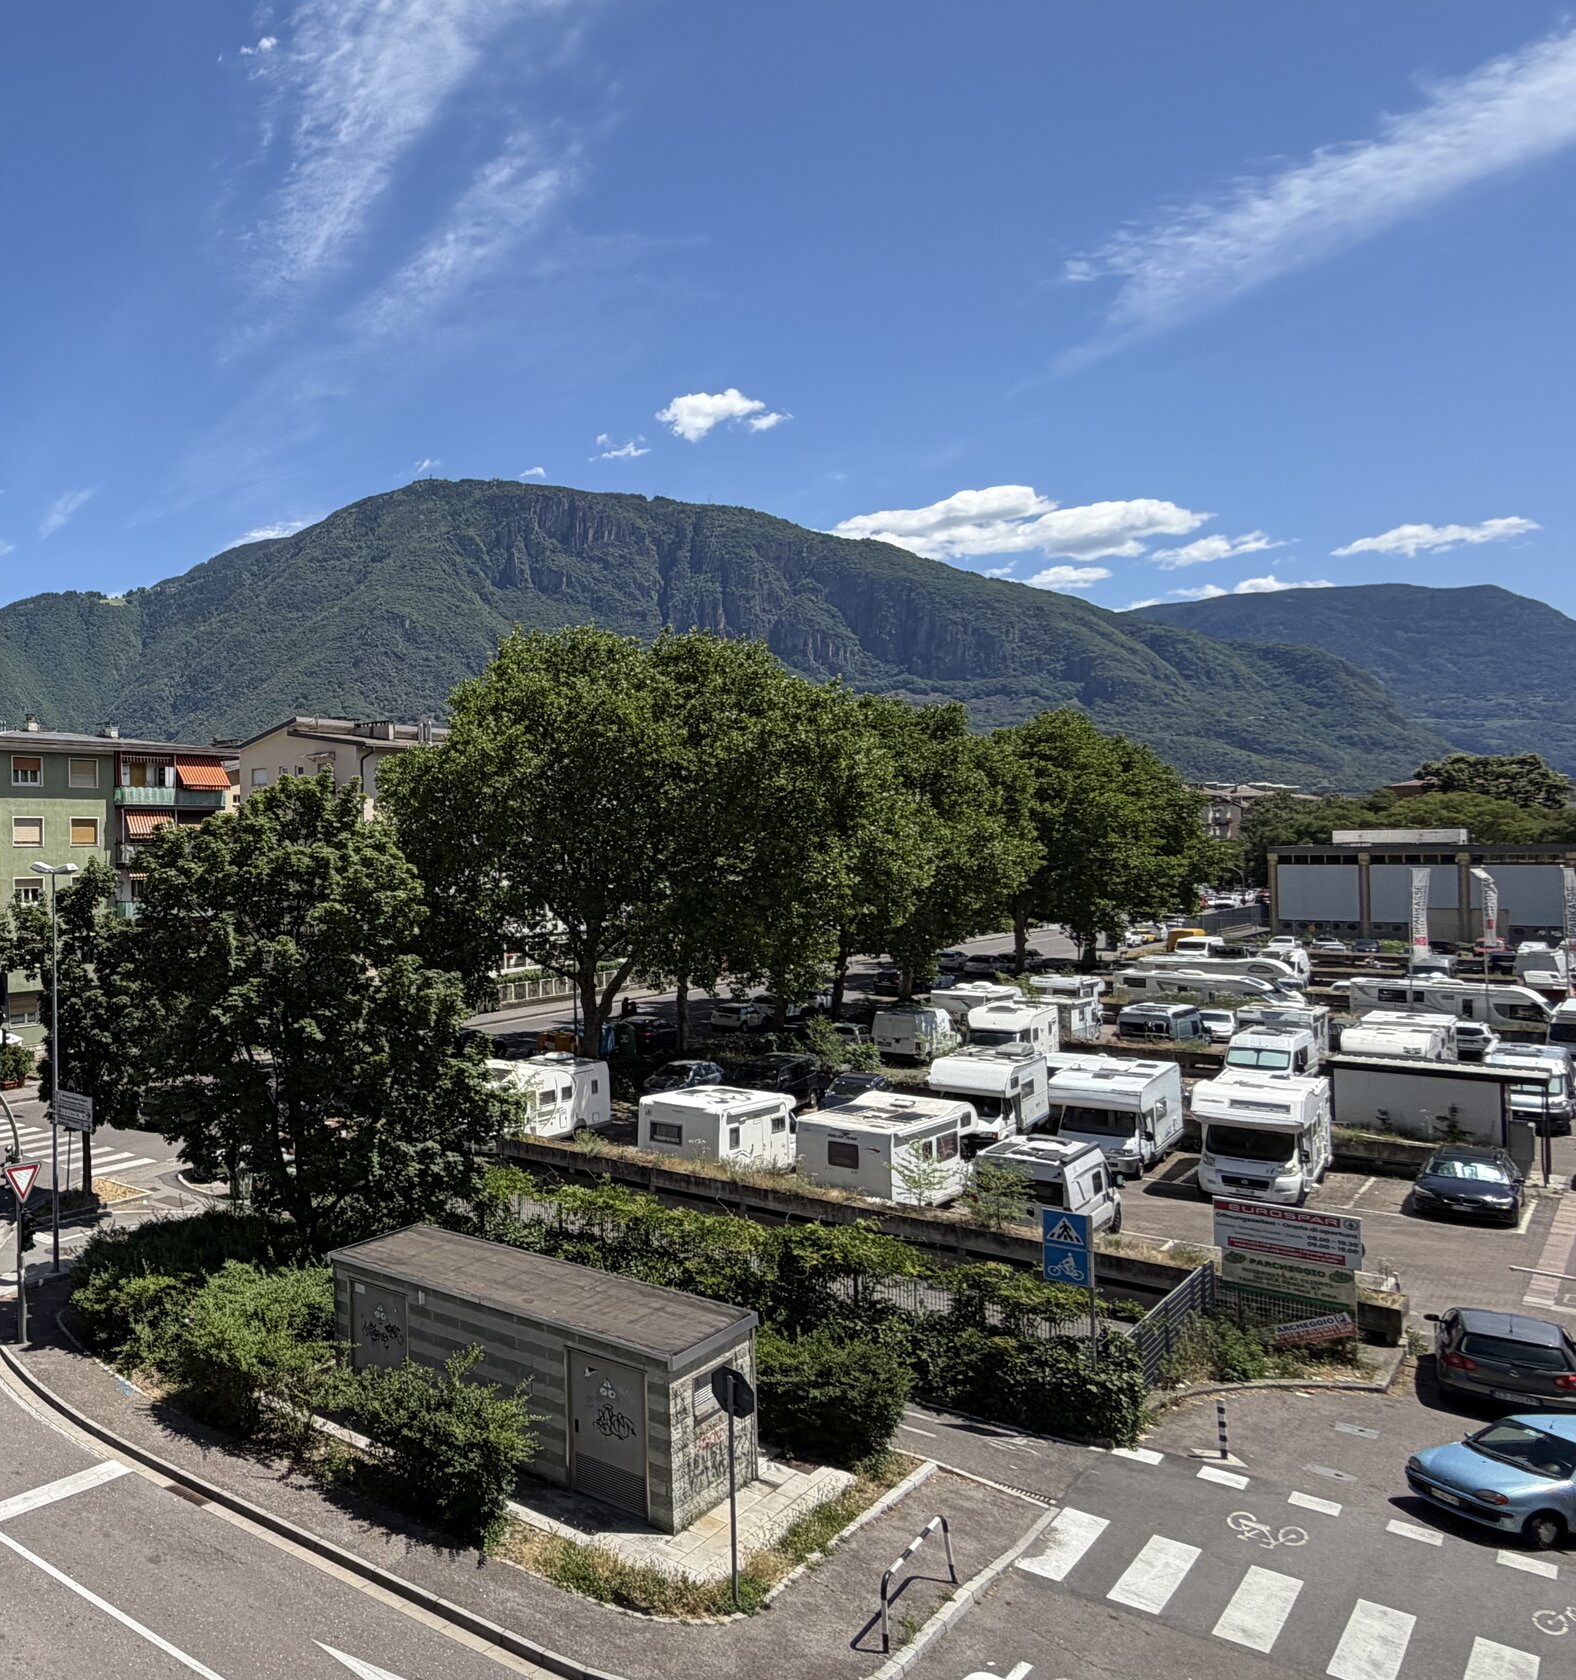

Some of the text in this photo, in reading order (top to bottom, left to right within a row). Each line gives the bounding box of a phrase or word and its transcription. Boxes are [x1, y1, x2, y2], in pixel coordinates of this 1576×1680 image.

[1228, 1203, 1338, 1226] EUROSPAR
[1249, 1258, 1326, 1278] PARCHEGGIO
[1276, 1317, 1335, 1333] ARCHEGGIO
